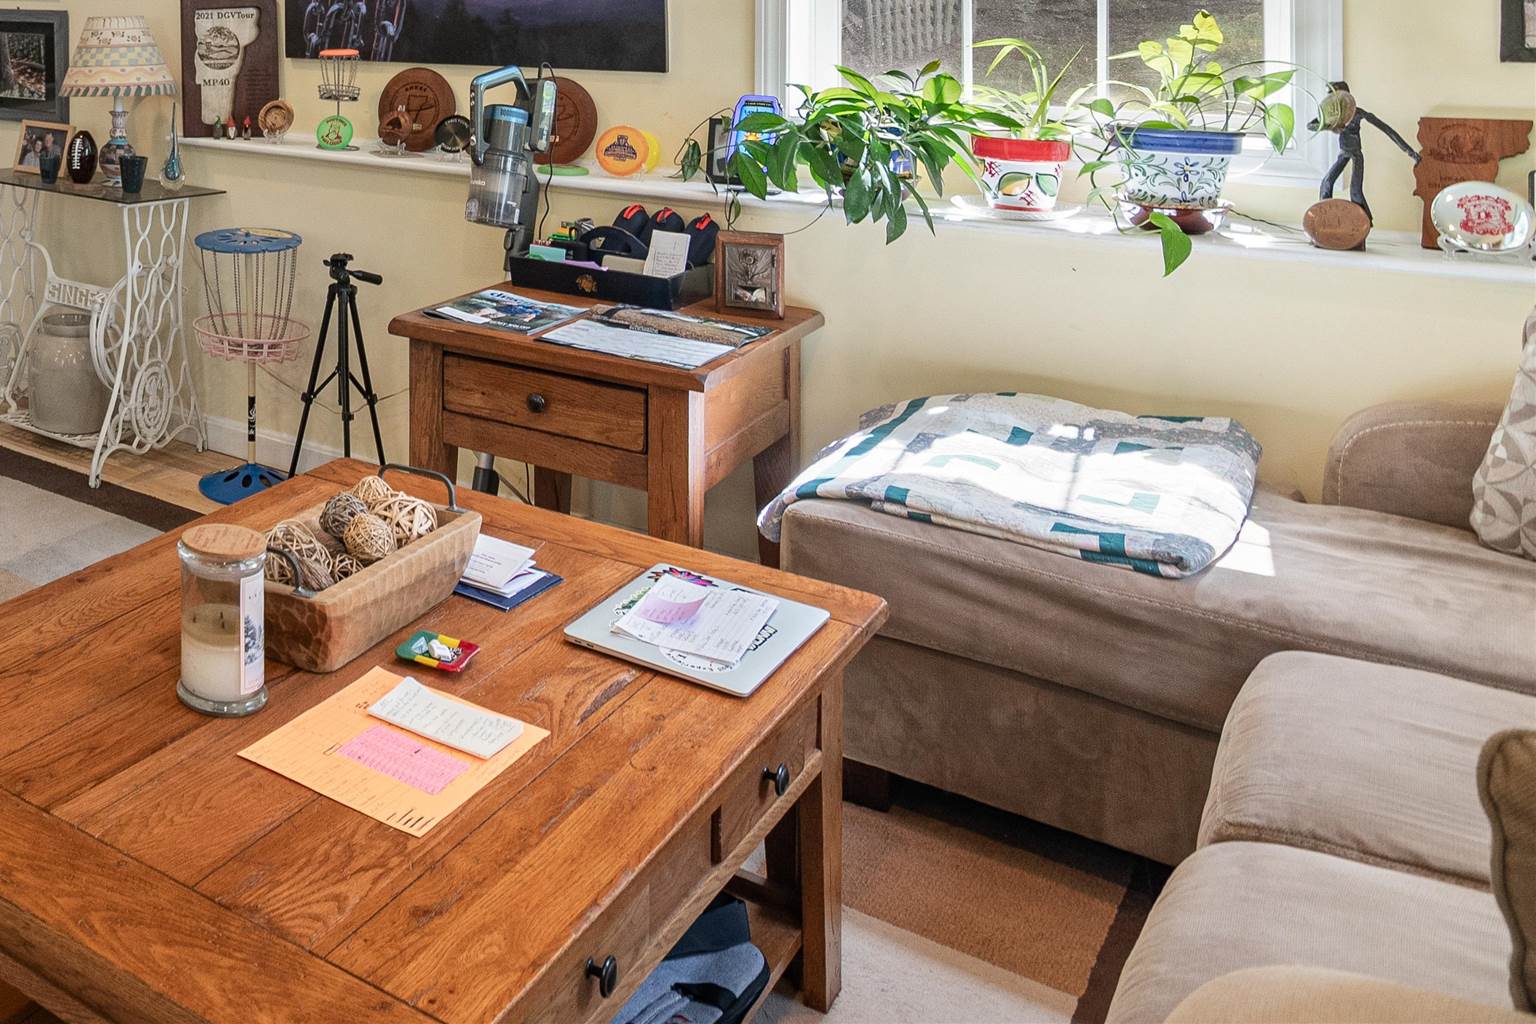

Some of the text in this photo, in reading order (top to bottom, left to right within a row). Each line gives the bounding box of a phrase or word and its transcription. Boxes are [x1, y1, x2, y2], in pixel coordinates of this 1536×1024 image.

[195, 11, 255, 20] 2021 DGVTour
[202, 78, 231, 87] MP40
[48, 282, 107, 309] SINGE
